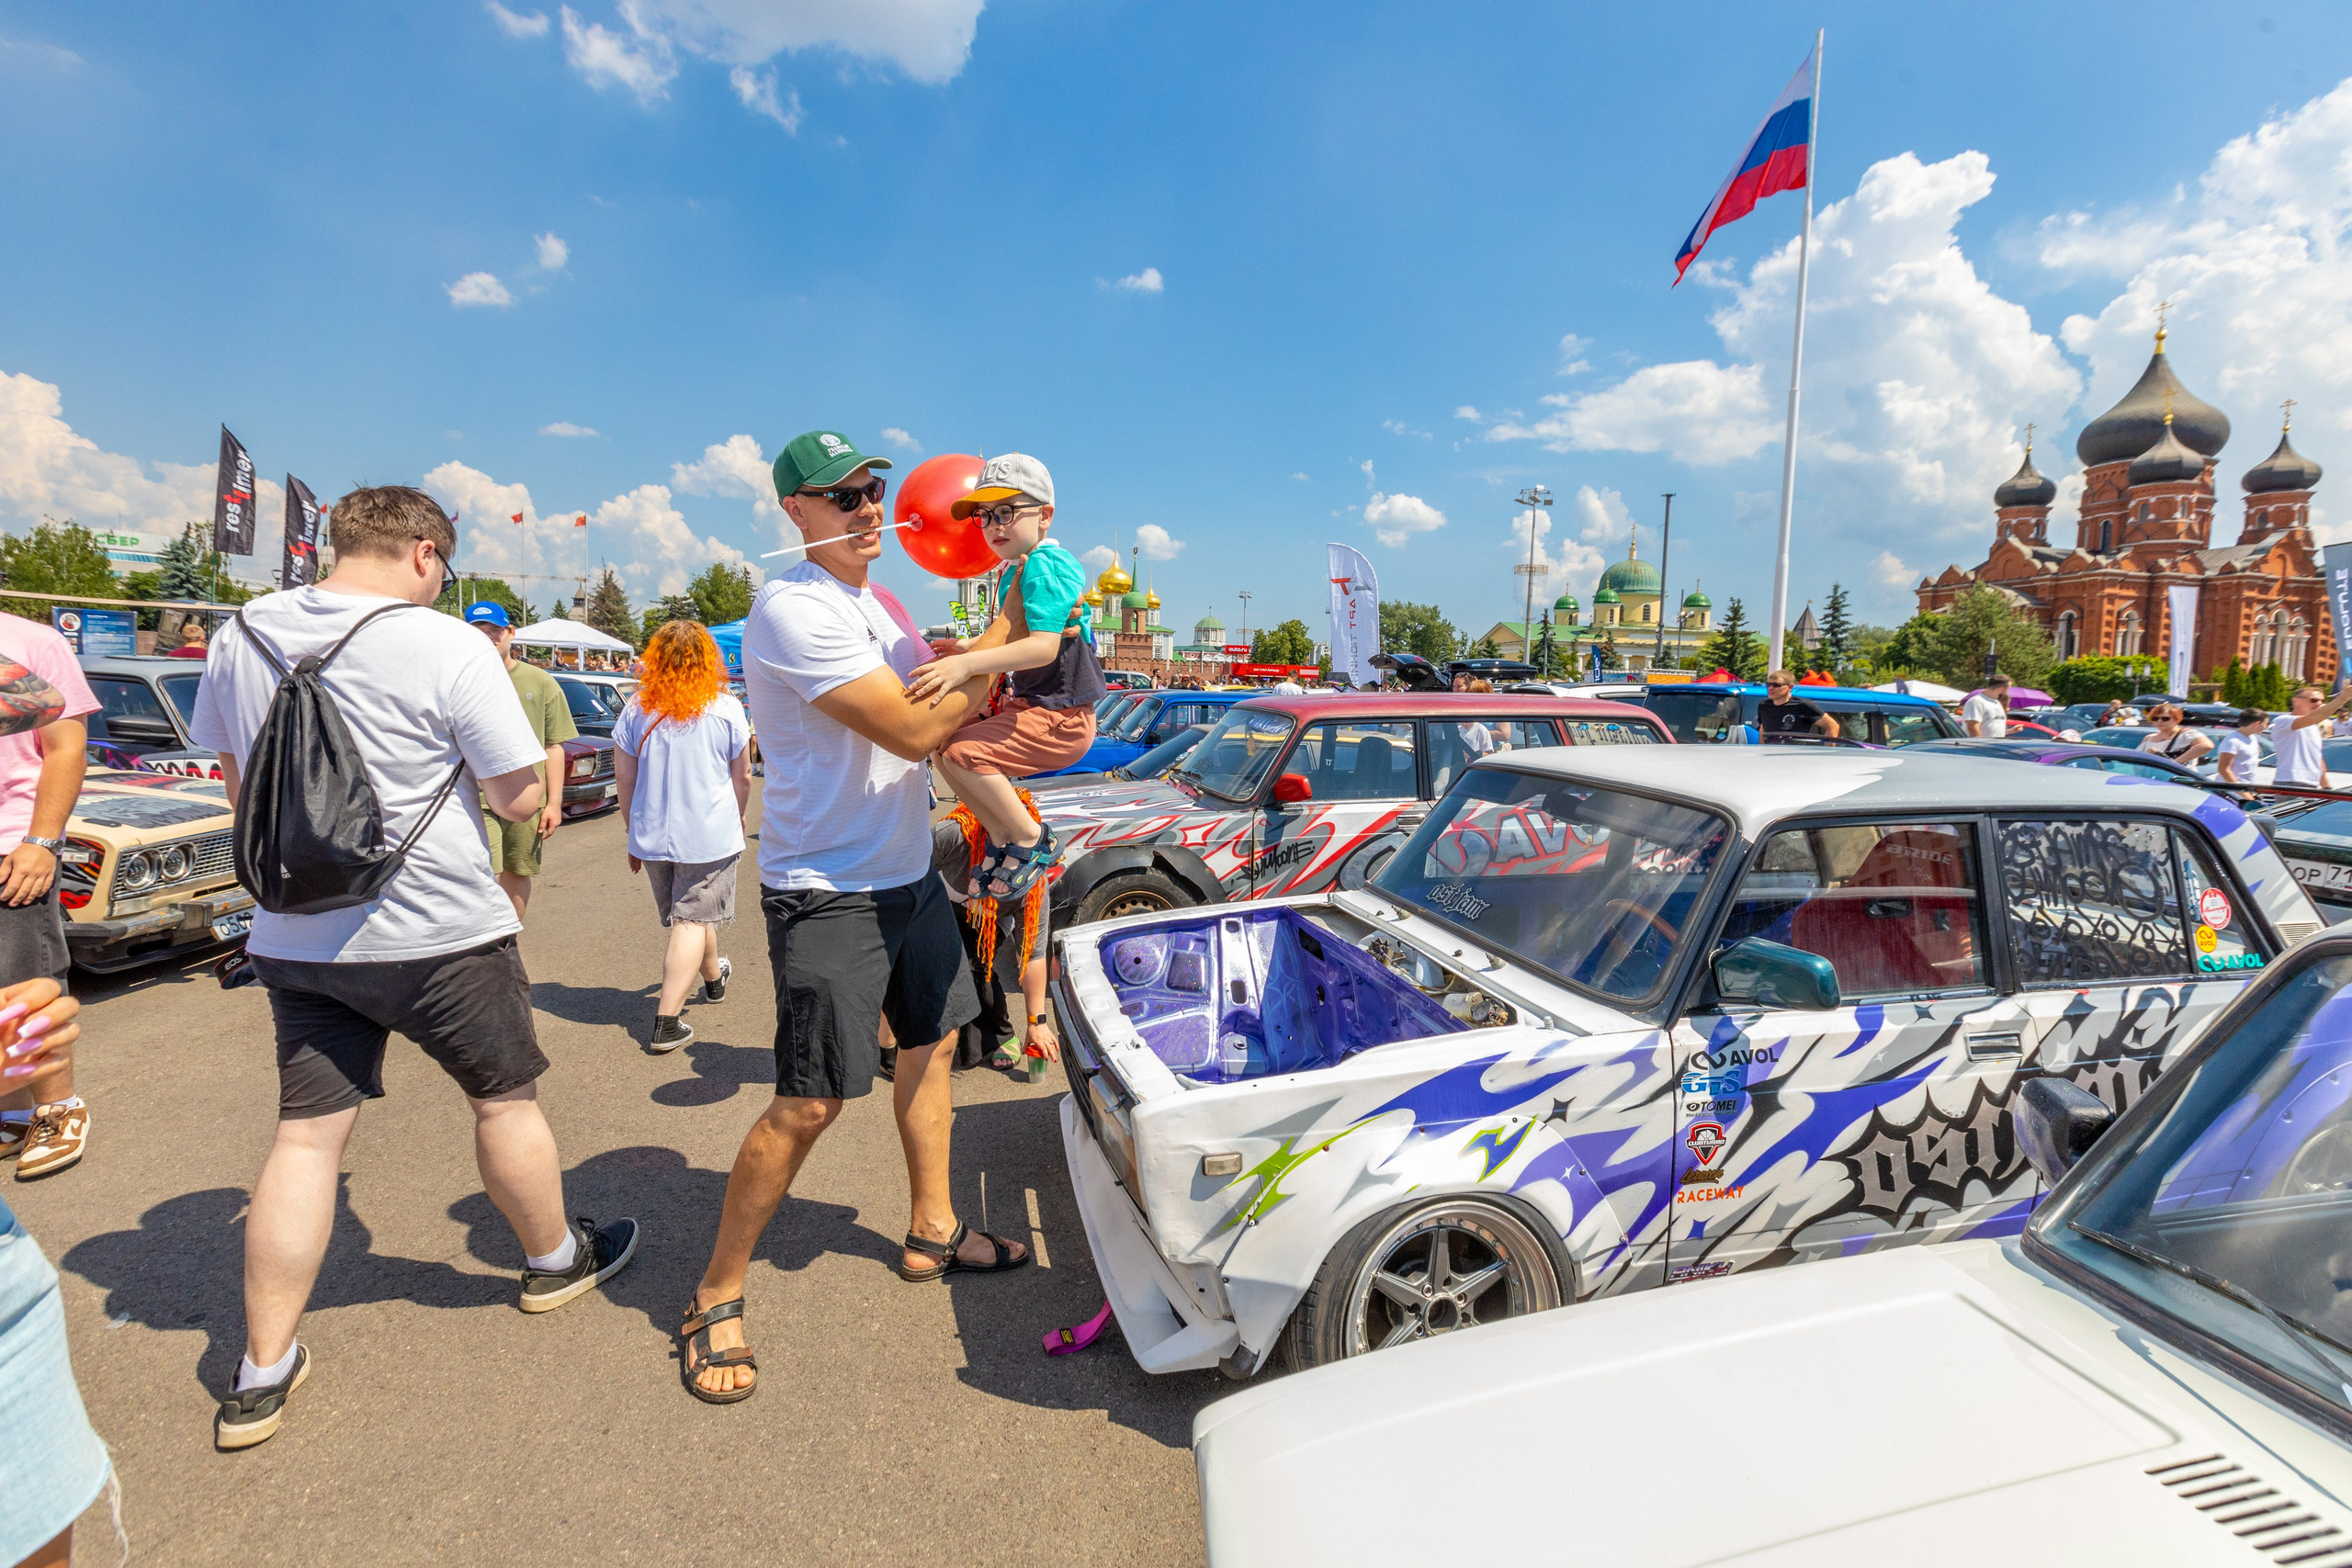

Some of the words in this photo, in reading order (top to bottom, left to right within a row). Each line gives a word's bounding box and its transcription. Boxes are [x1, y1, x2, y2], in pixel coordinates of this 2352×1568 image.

[96, 533, 140, 547] СБЕР
[1886, 843, 1953, 864] BRIDE
[2331, 866, 2352, 883] 71
[224, 957, 243, 970] EOS
[2226, 953, 2265, 969] AVOL
[1730, 1047, 1779, 1066] AVOL
[1681, 1069, 1741, 1096] GTS
[1701, 1100, 1736, 1111] TOMEI
[1677, 1185, 1746, 1204] RACEWAY
